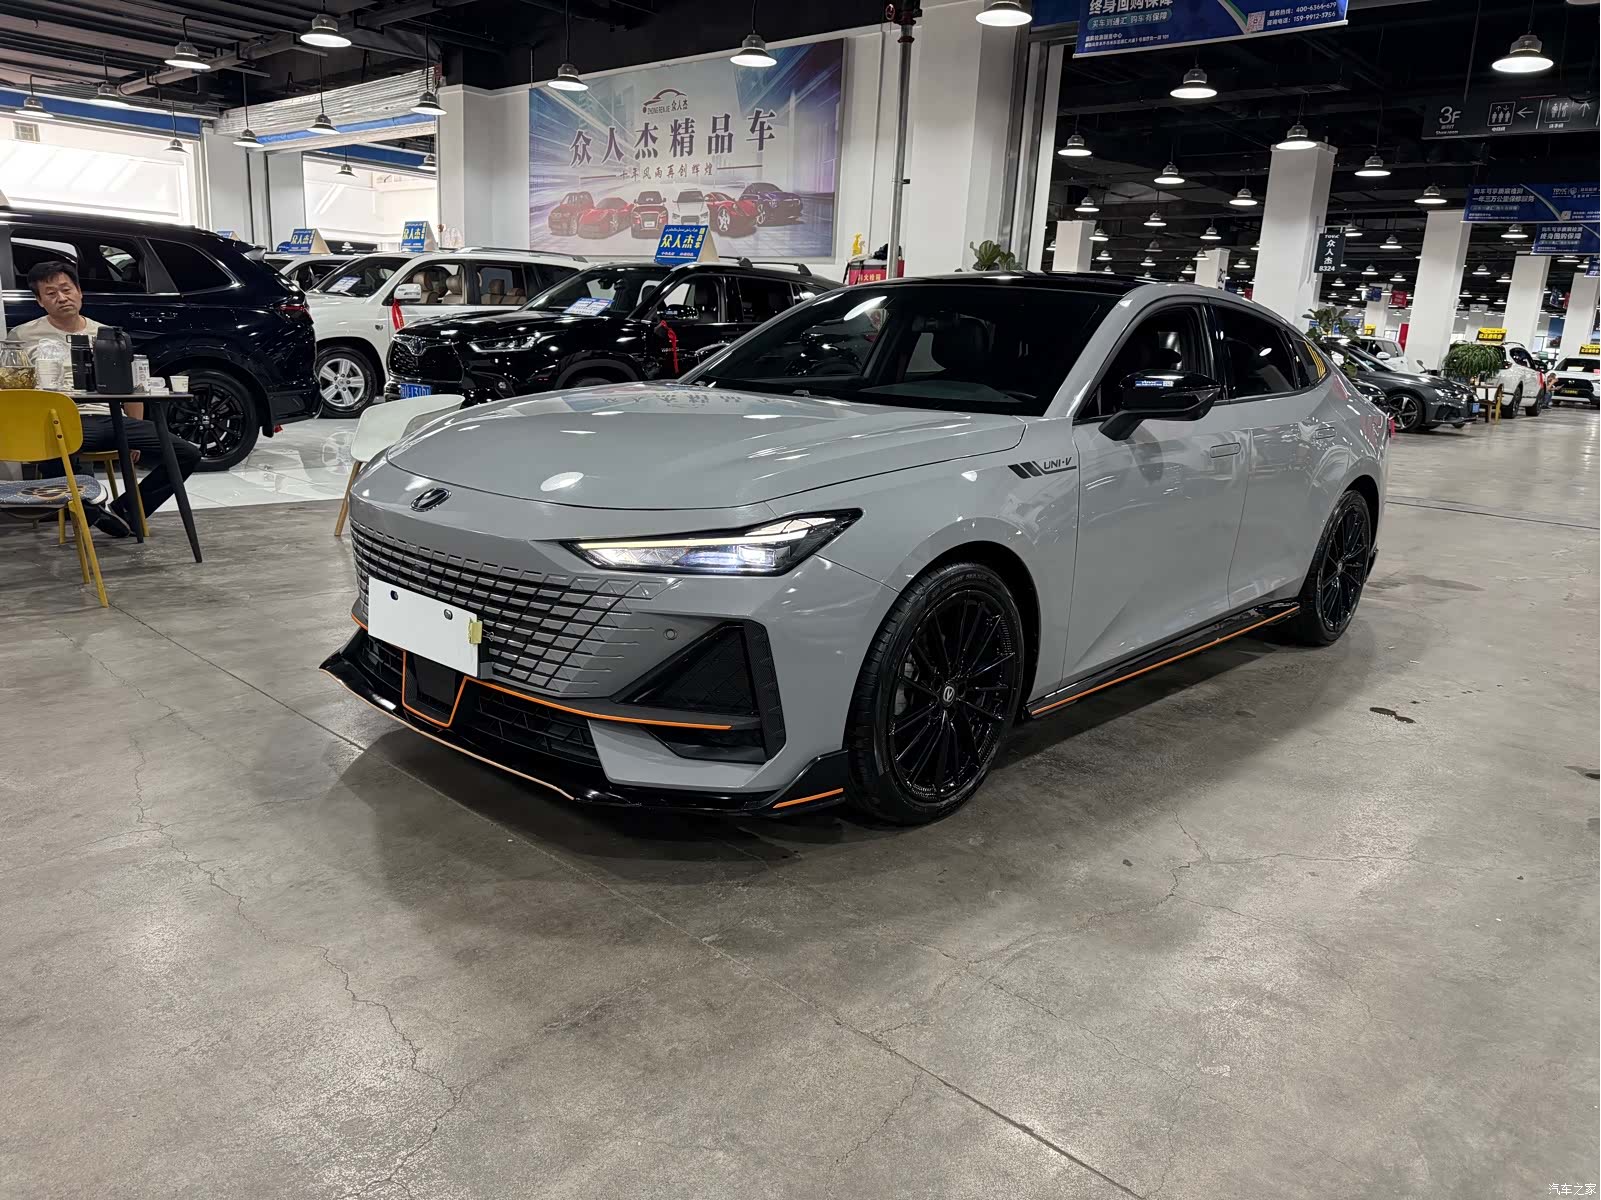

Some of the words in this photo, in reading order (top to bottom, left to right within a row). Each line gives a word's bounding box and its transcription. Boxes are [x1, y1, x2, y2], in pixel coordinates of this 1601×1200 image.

[671, 100, 688, 111] 众人杰
[1440, 106, 1461, 124] 3F
[569, 109, 776, 167] 众人杰精品车
[620, 162, 713, 181] 十年风雨再创辉煌
[660, 234, 695, 249] 众人杰
[1324, 239, 1336, 265] 众人杰
